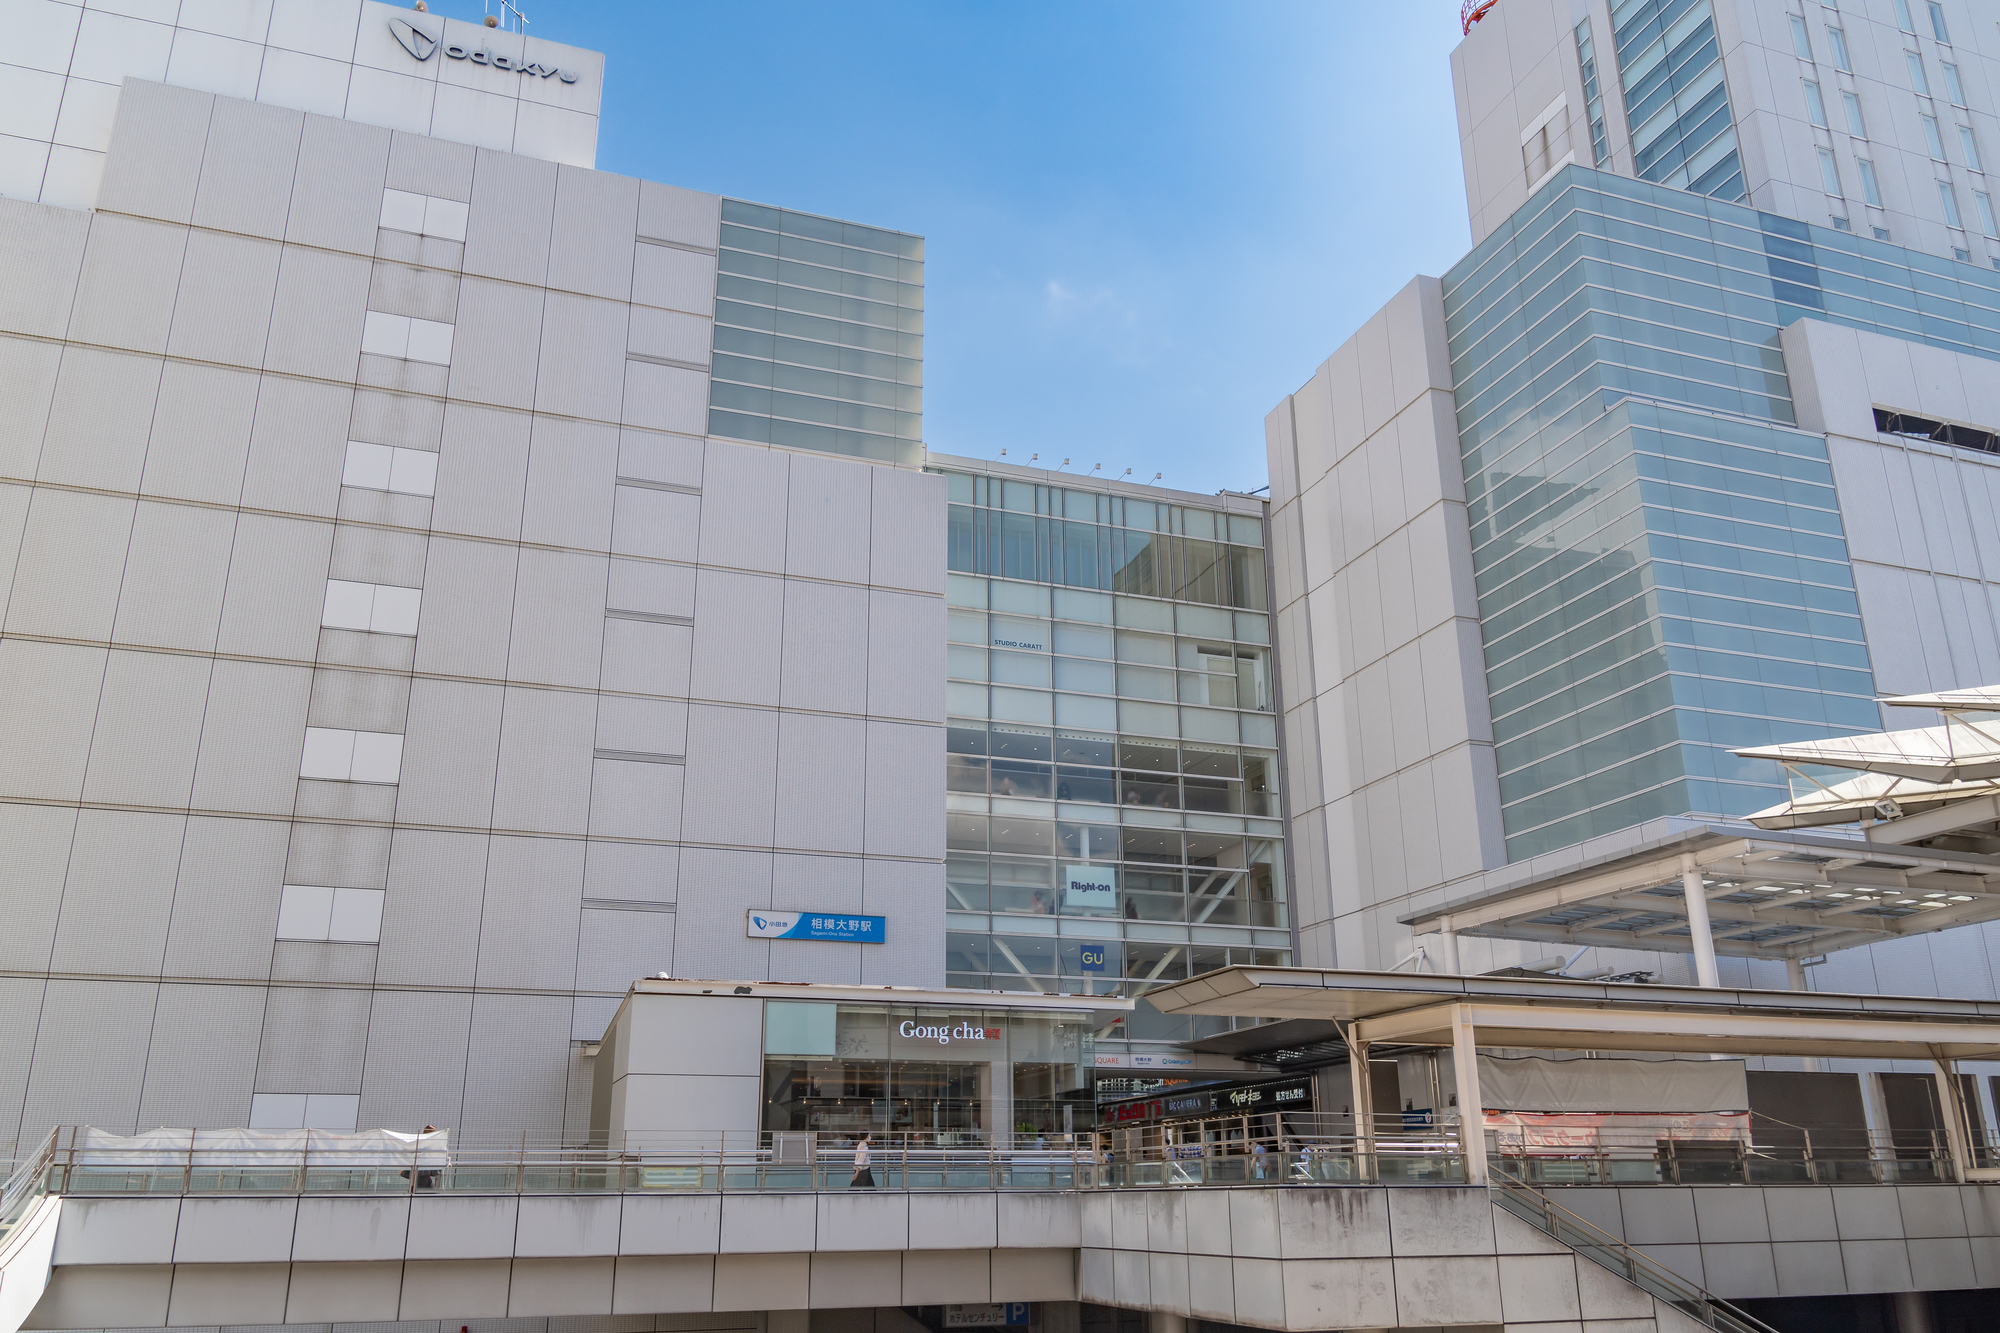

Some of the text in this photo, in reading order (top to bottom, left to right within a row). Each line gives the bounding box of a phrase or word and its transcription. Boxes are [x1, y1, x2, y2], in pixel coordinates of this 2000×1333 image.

[444, 45, 577, 84] odakyu
[994, 639, 1018, 647] STUDIO
[1071, 881, 1110, 892] Right-on
[811, 918, 872, 932] 相模大野駅
[1082, 952, 1103, 965] GU
[899, 1020, 950, 1045] Gong
[952, 1021, 985, 1040] cha
[1094, 1056, 1119, 1065] SQUARE
[1119, 1100, 1161, 1121] ビックカラ
[1012, 1303, 1025, 1321] P
